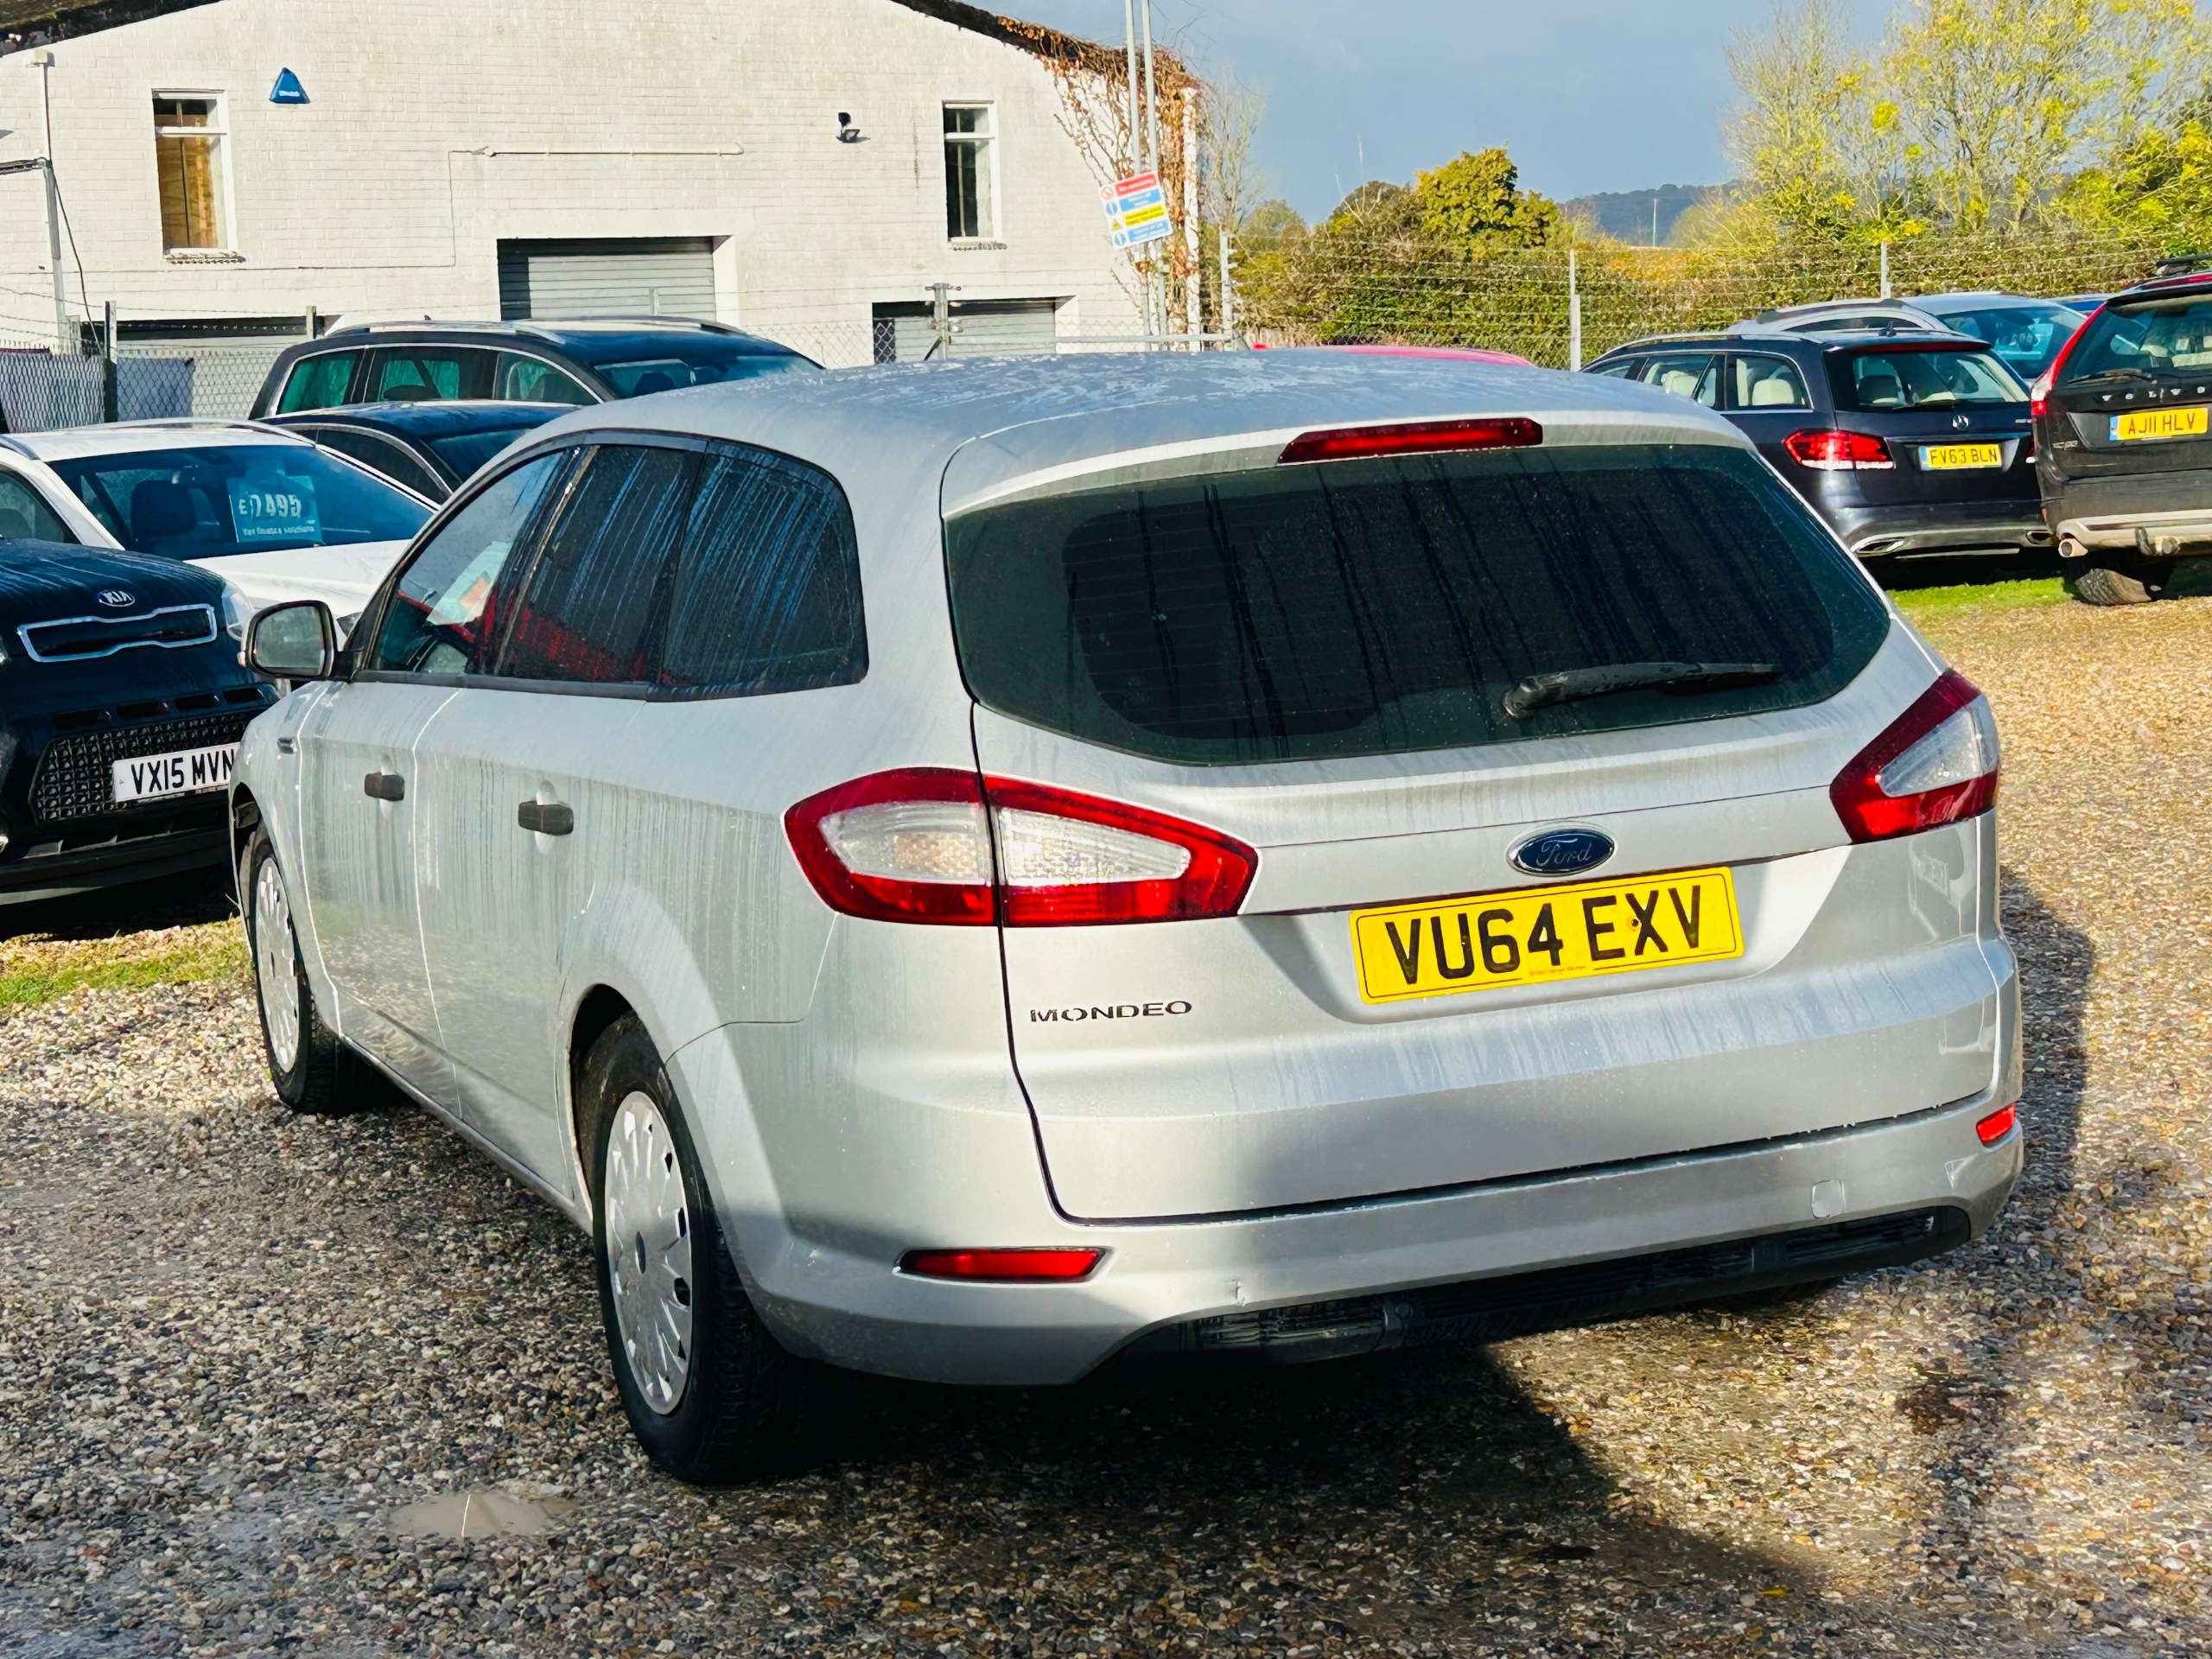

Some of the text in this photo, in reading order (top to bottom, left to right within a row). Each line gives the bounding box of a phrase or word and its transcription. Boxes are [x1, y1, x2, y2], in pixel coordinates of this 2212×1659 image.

[2101, 386, 2206, 402] VOLVO
[2127, 412, 2196, 435] AJ11 HLV
[1929, 446, 1998, 465] FV63 BLN
[102, 590, 133, 604] KIA
[130, 757, 185, 795] VX15
[1536, 838, 1592, 867] Ford
[1384, 885, 1701, 985] VU64 EXV
[1030, 1001, 1192, 1022] MONDEO
